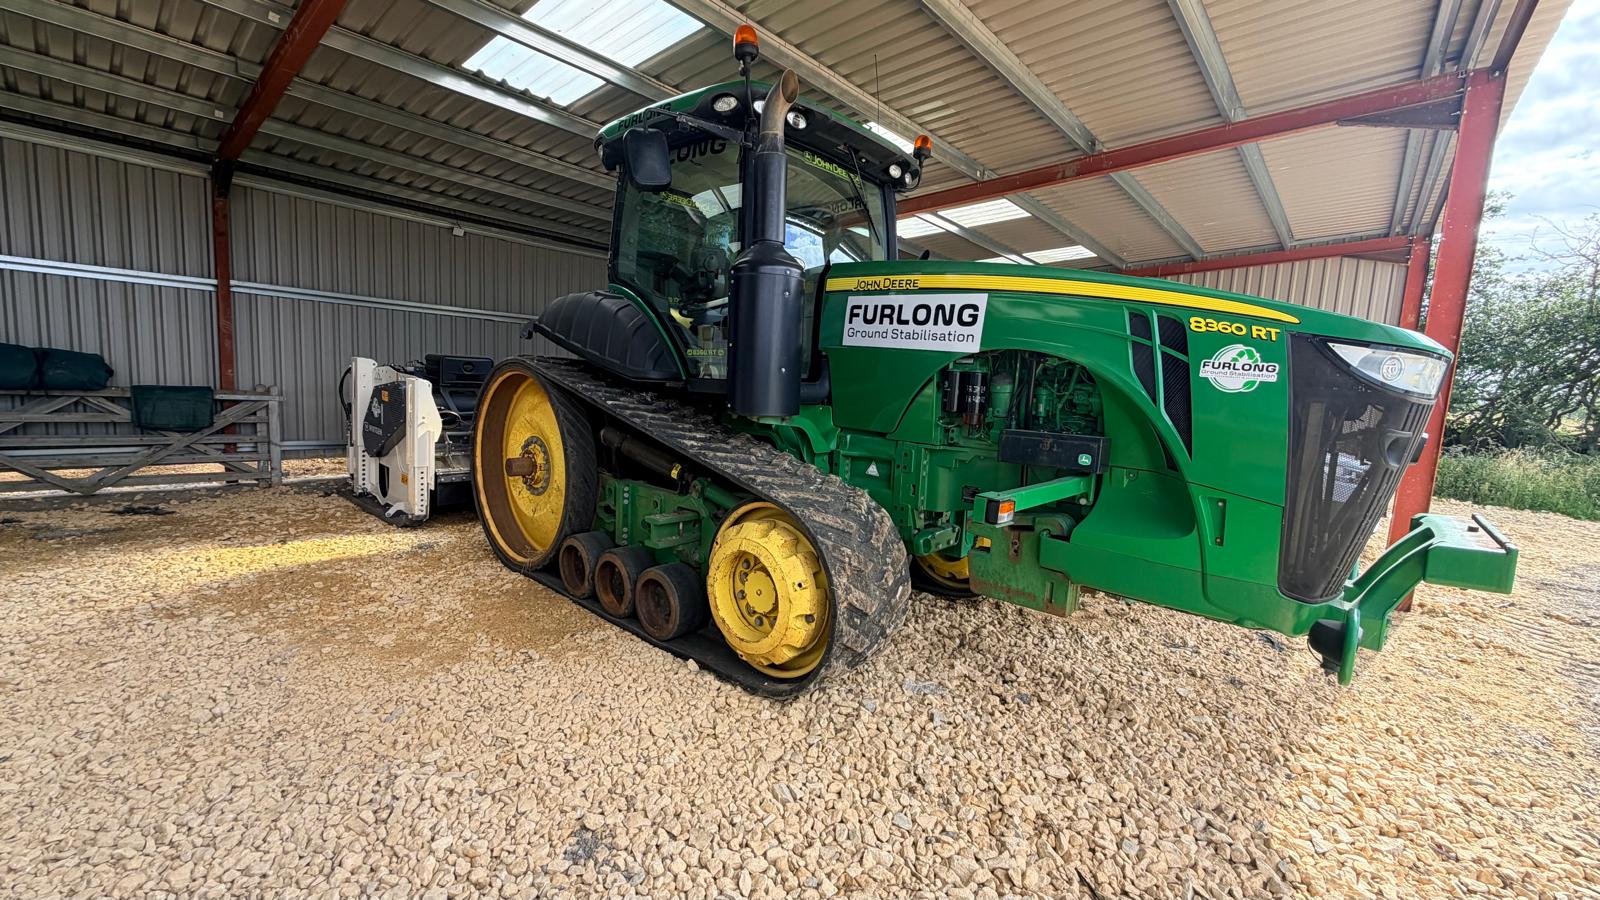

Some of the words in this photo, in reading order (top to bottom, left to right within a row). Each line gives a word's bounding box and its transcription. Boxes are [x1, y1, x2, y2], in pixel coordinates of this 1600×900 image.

[812, 155, 833, 170] JOHN
[854, 279, 881, 290] JOHN
[883, 278, 919, 289] DEERE
[849, 303, 979, 326] FURLONG
[847, 327, 888, 339] Ground
[890, 328, 975, 343] Stabilisation
[1189, 317, 1247, 336] 8360
[1252, 325, 1281, 341] RT
[1202, 361, 1277, 373] FURLONG
[1229, 371, 1276, 379] Stabilisation
